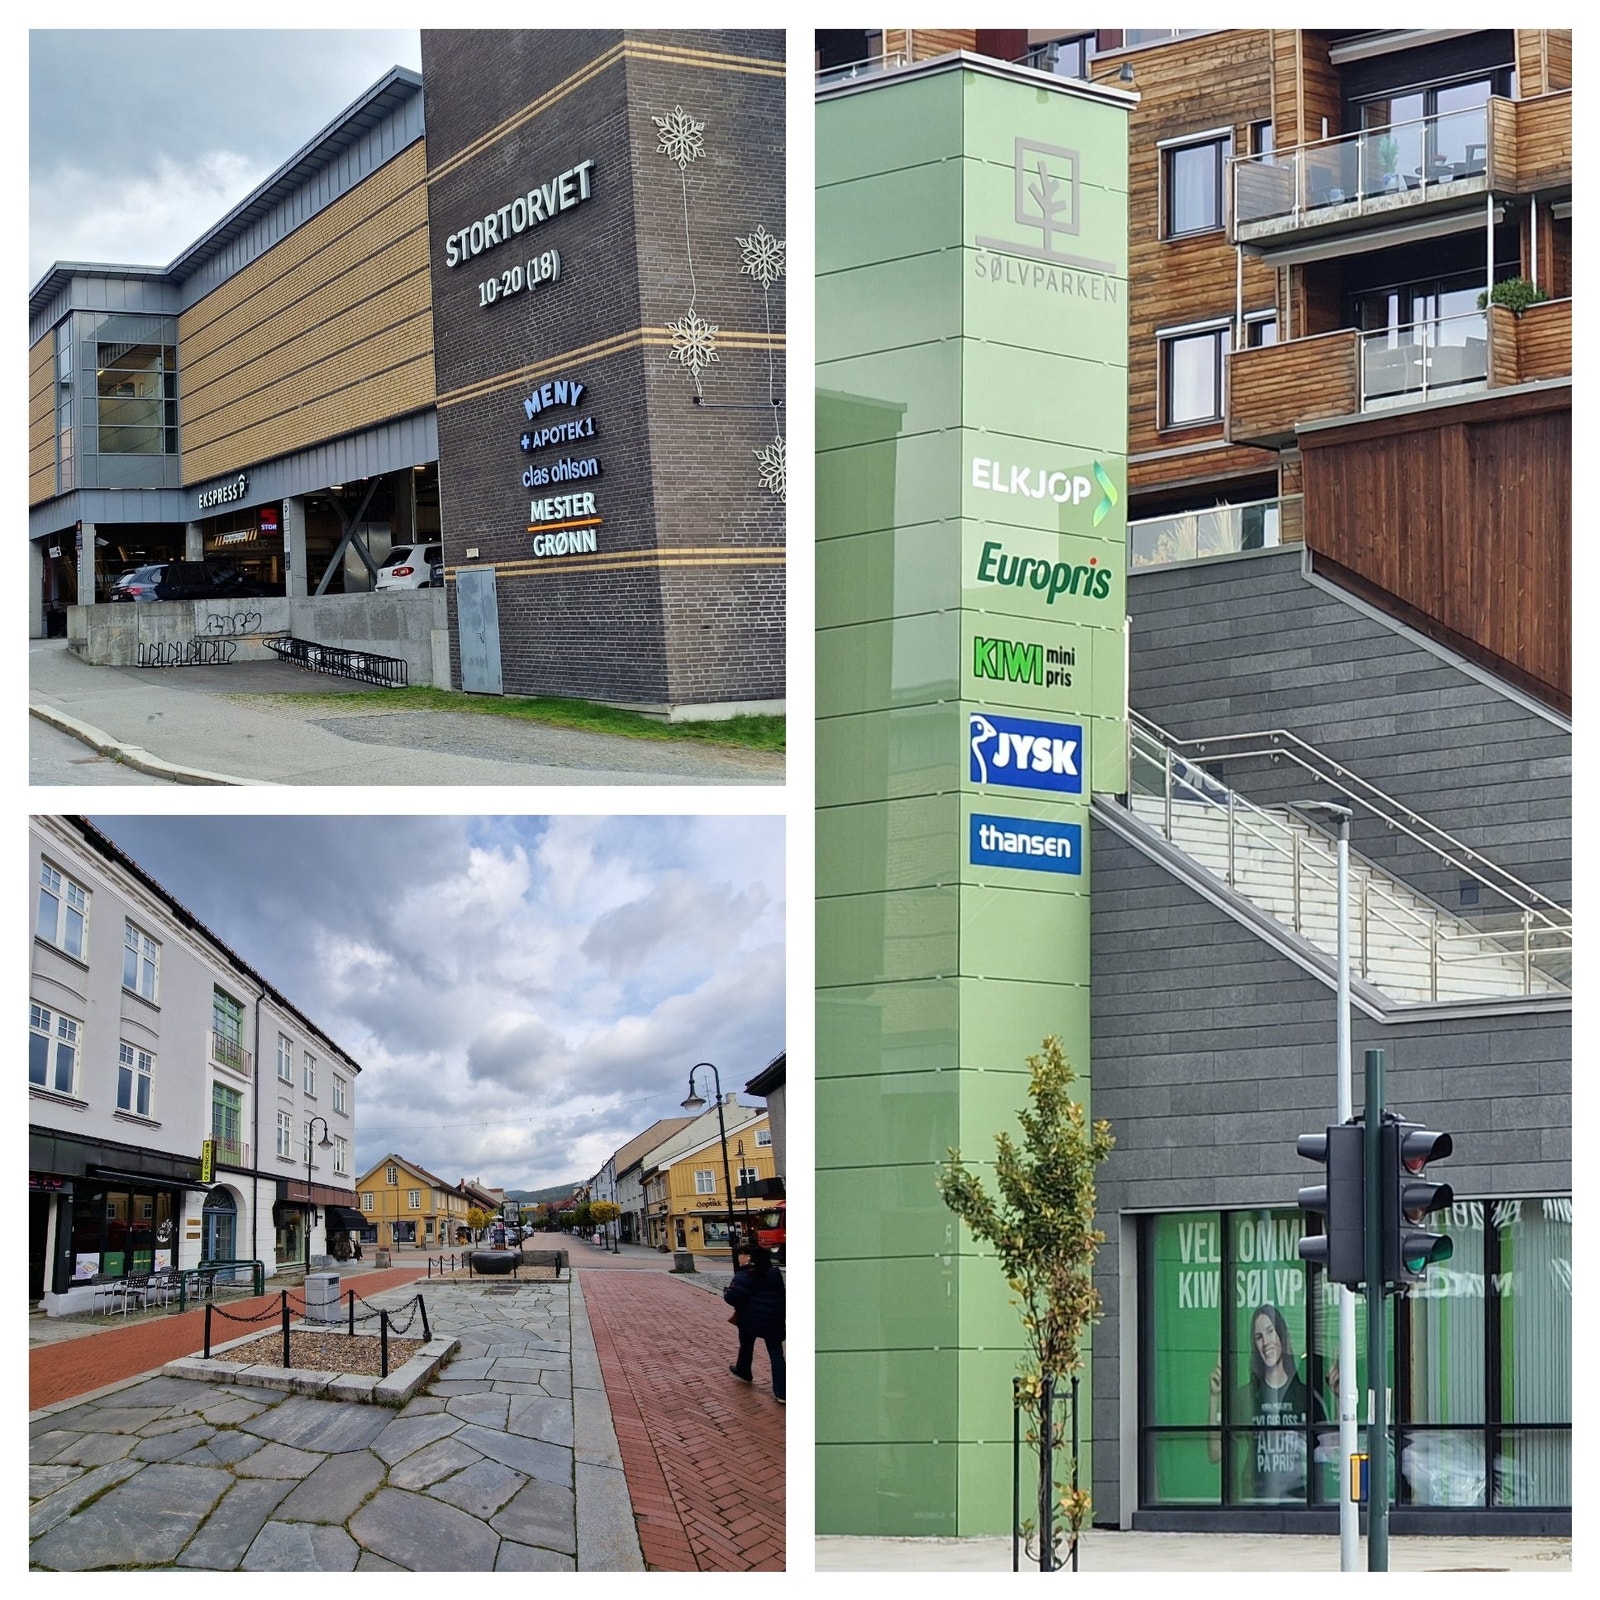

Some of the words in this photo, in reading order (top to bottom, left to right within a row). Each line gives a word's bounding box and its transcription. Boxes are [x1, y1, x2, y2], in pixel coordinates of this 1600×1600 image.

[446, 159, 595, 268] STORTORVET
[478, 265, 525, 307] 10-20
[526, 250, 561, 291] (18)
[974, 255, 1117, 303] SØLVPARKEN
[523, 380, 584, 420] MENY
[522, 465, 550, 488] clas
[551, 457, 599, 482] ohlson
[198, 483, 238, 509] EKSPRESS
[530, 492, 598, 522] MESTER
[260, 523, 278, 531] STOR
[533, 529, 598, 557] GRØNN
[976, 541, 1112, 605] Europris
[973, 635, 1044, 686] KIWI
[1046, 645, 1075, 666] mini
[1046, 667, 1072, 688] pris
[992, 732, 1079, 776] JYSK
[978, 823, 1072, 859] thansen
[1178, 1270, 1221, 1309] KIW
